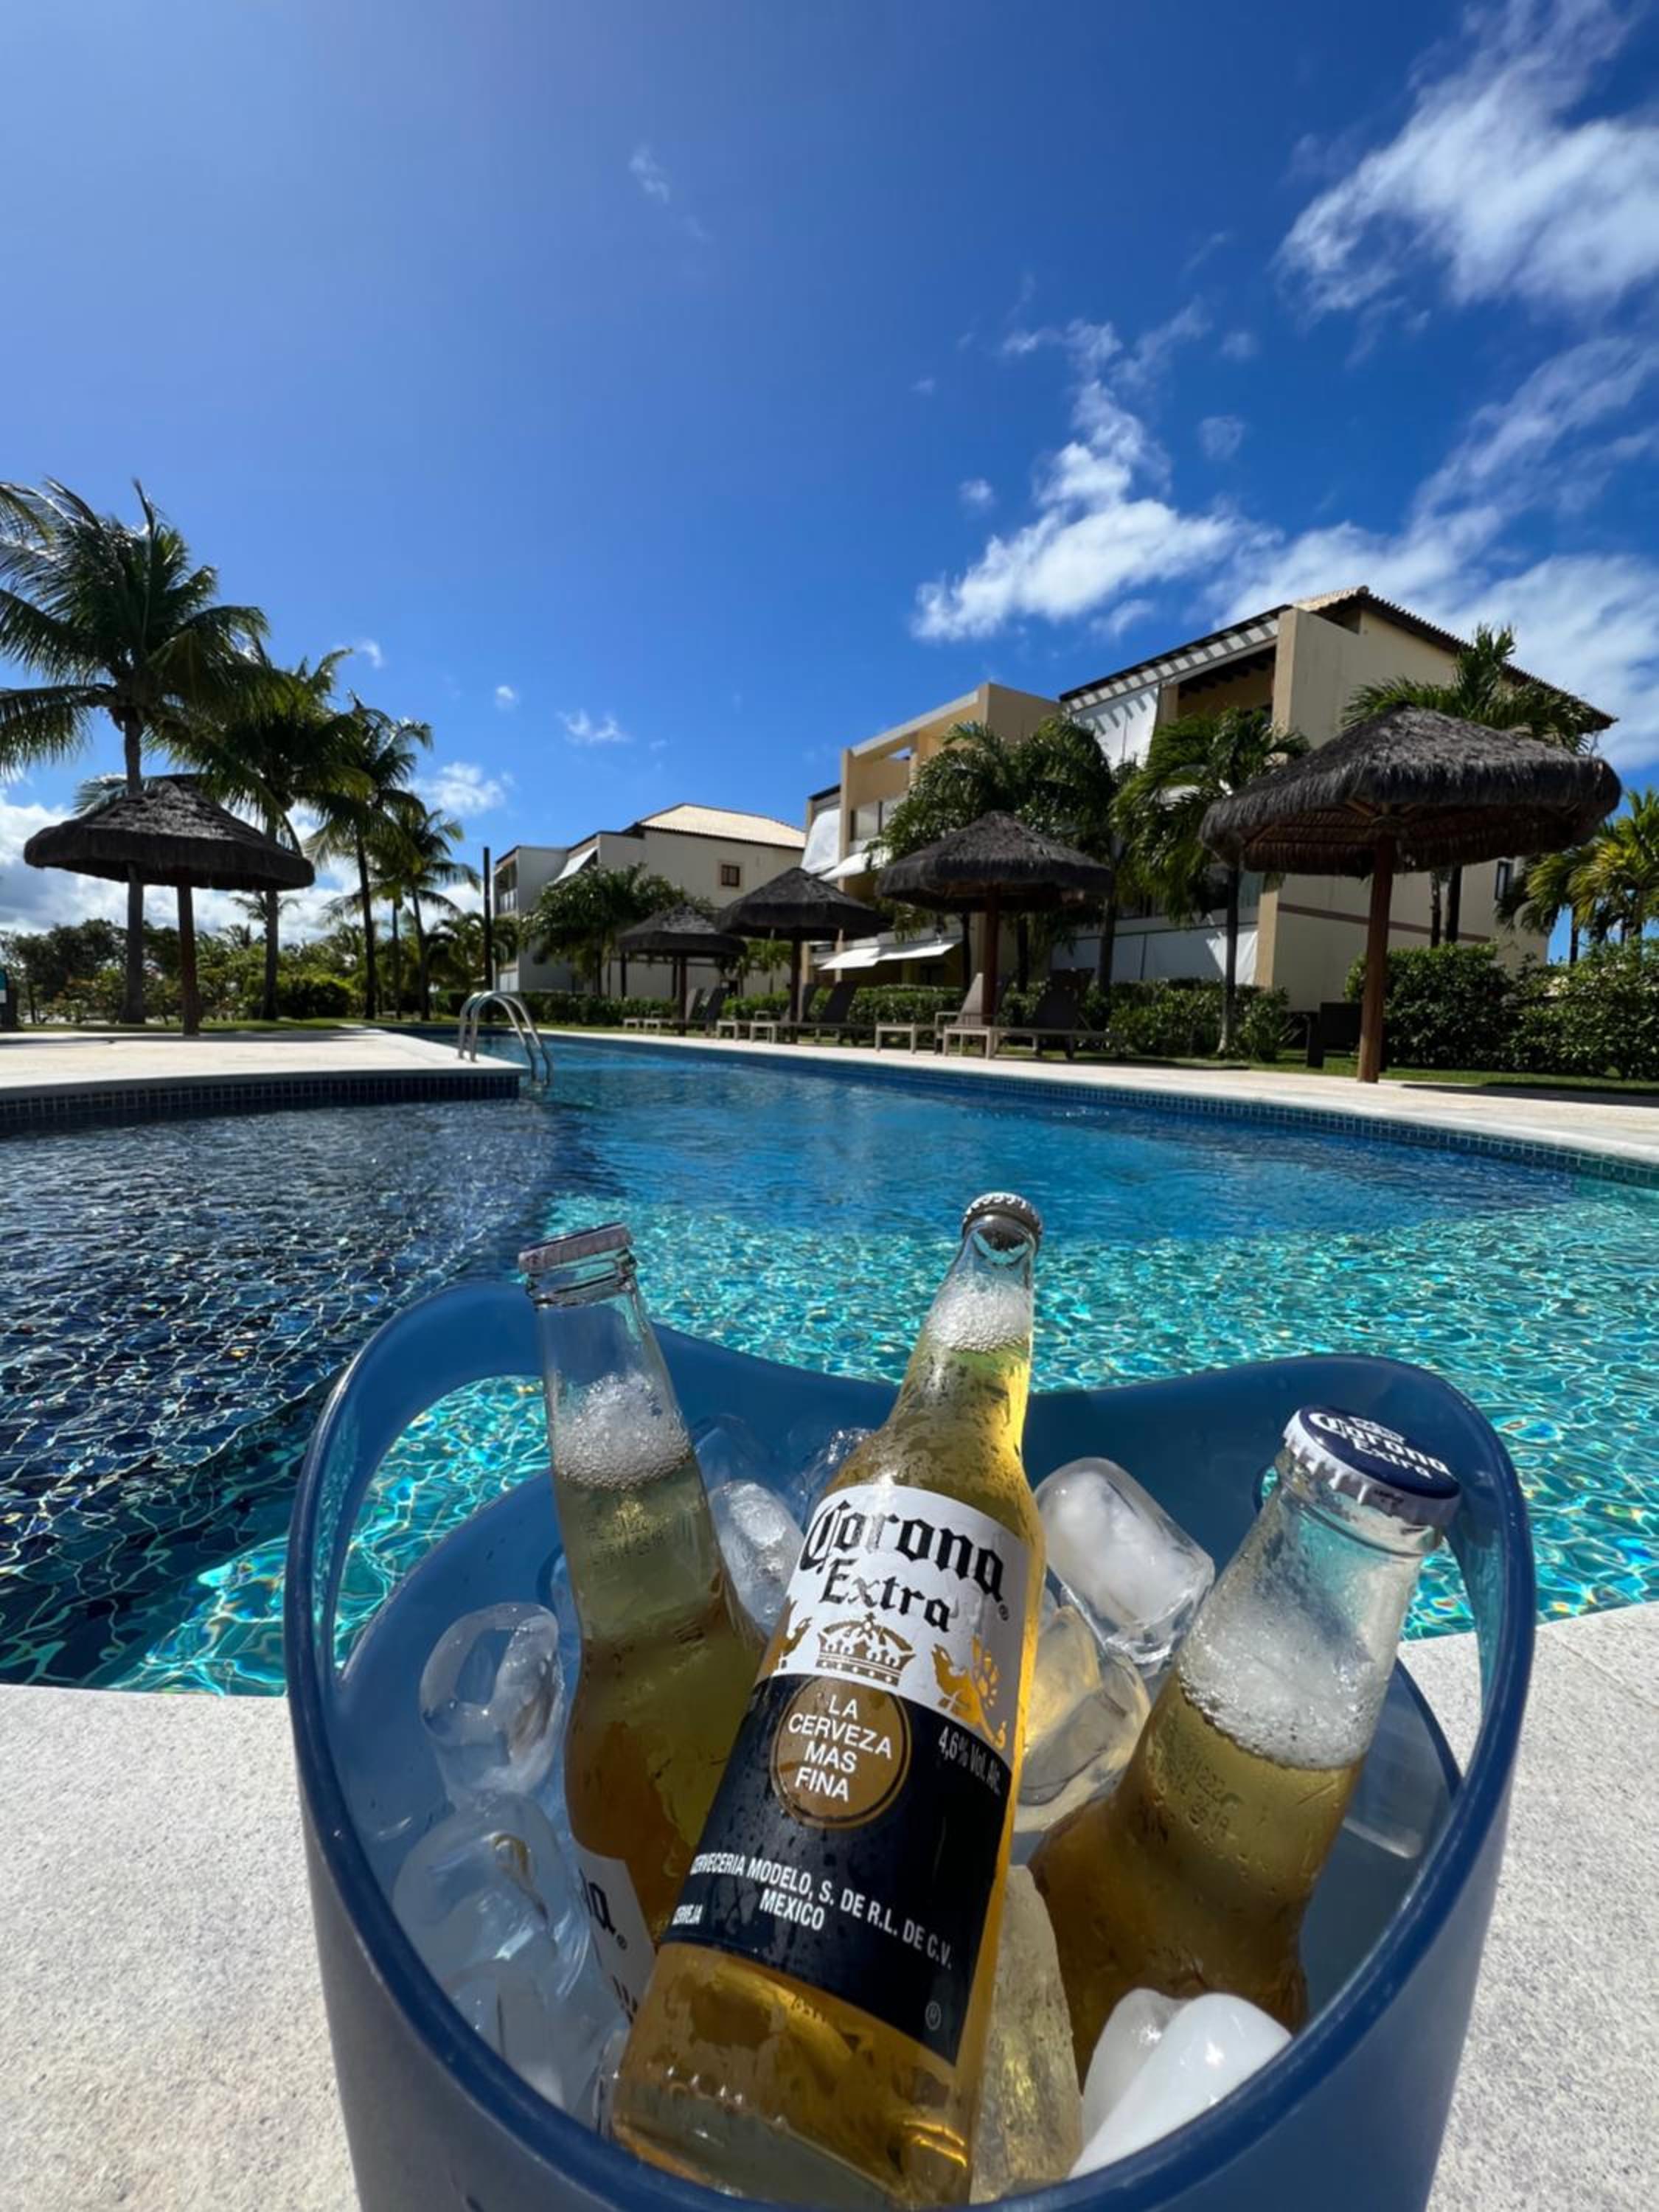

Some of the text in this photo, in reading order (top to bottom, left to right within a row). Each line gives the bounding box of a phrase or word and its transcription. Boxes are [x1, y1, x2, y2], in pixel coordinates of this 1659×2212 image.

[1309, 1413, 1453, 1478] Corona
[1352, 1438, 1433, 1479] Extra
[799, 1500, 1004, 1603] Corona
[819, 1557, 951, 1632] Extra
[828, 1694, 858, 1721] LA
[787, 1712, 893, 1760] CERVEZA
[804, 1740, 858, 1774] MAS
[794, 1766, 849, 1803] FINA
[746, 1857, 814, 1901] MODELO,
[818, 1879, 835, 1906] S.
[840, 1888, 866, 1919] DE
[866, 1900, 898, 1937] R.L.
[902, 1918, 925, 1951] DE
[926, 1933, 953, 1971] C.V.
[758, 1888, 826, 1931] MEXICO
